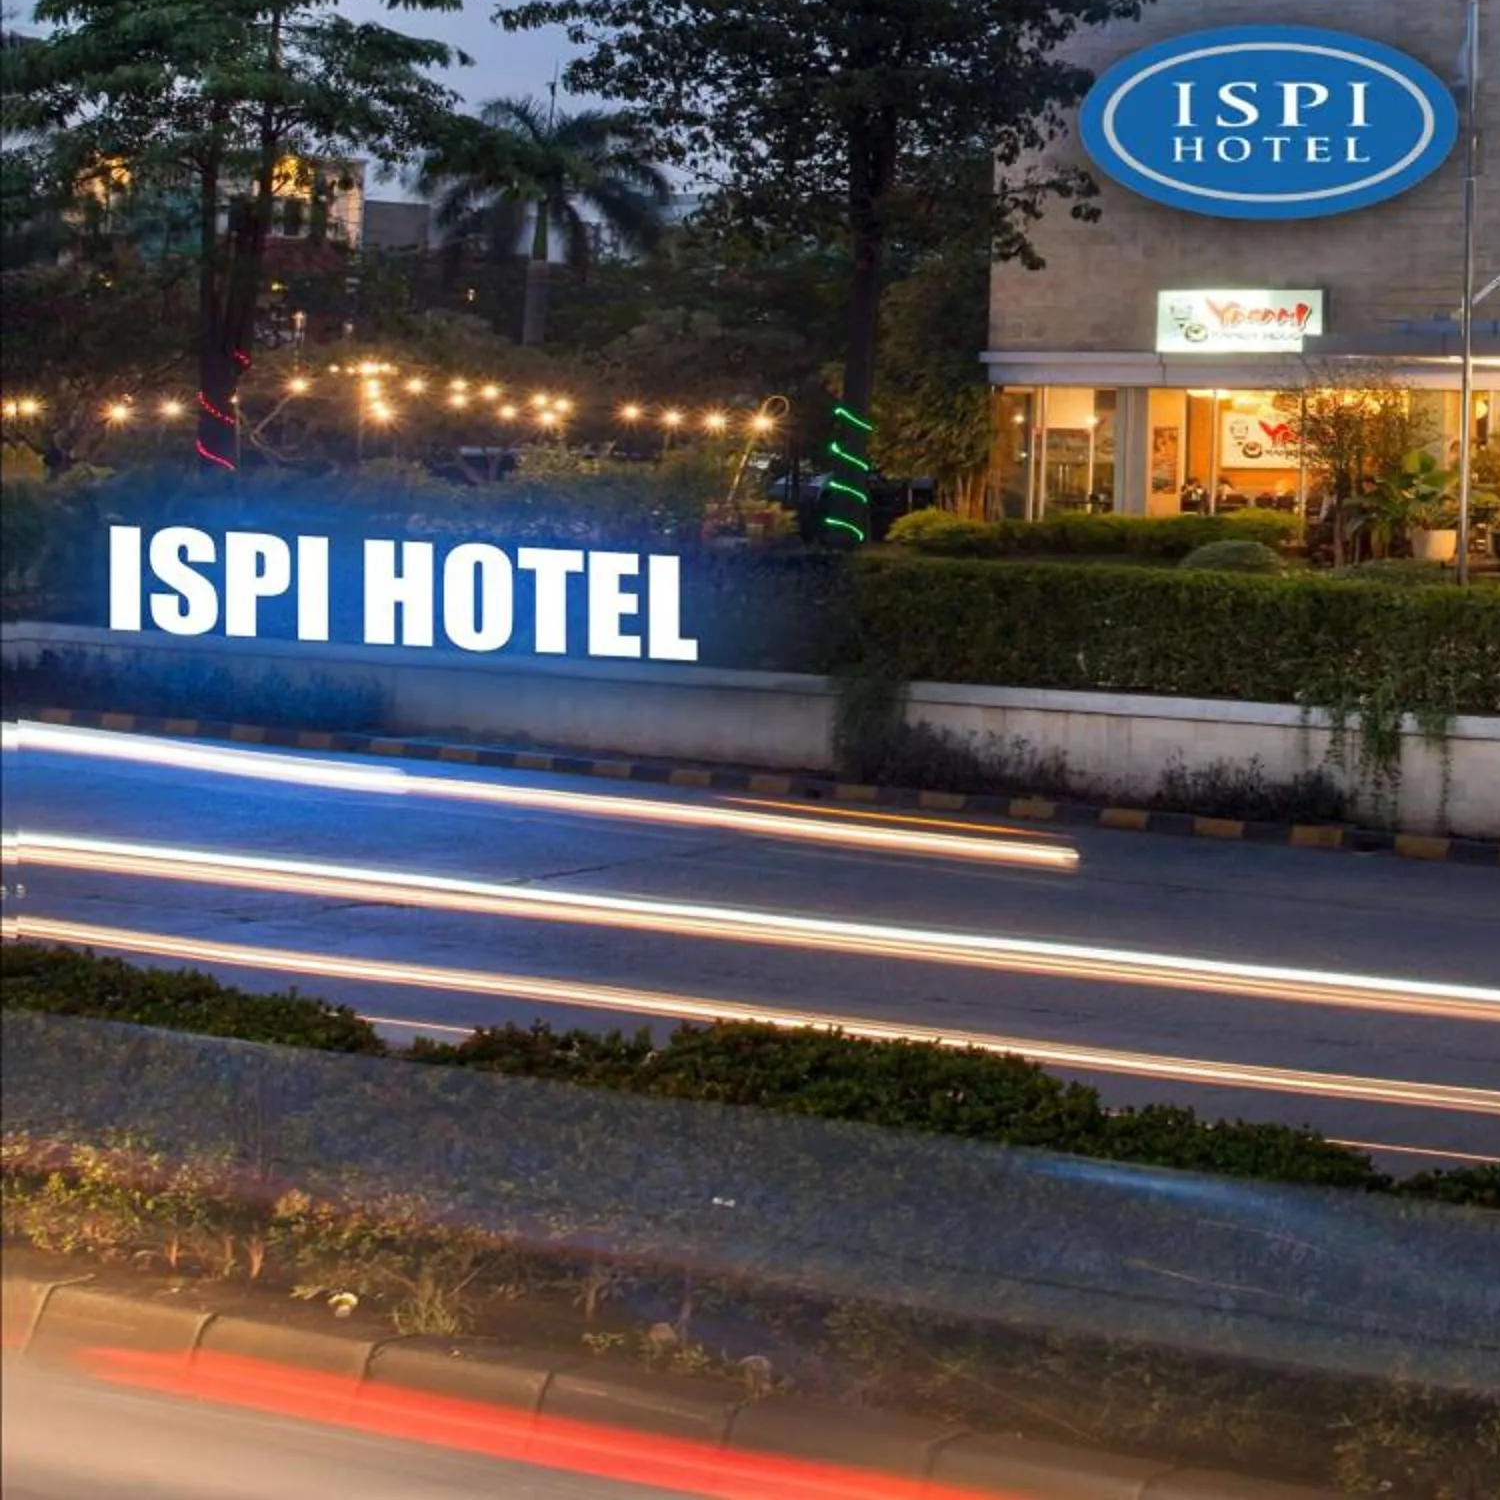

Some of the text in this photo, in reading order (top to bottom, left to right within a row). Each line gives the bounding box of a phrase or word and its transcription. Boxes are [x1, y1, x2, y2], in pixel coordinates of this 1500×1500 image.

[1173, 81, 1373, 127] ISPI
[1173, 137, 1371, 162] HOTEL
[110, 525, 698, 661] ISPI HOTEL
